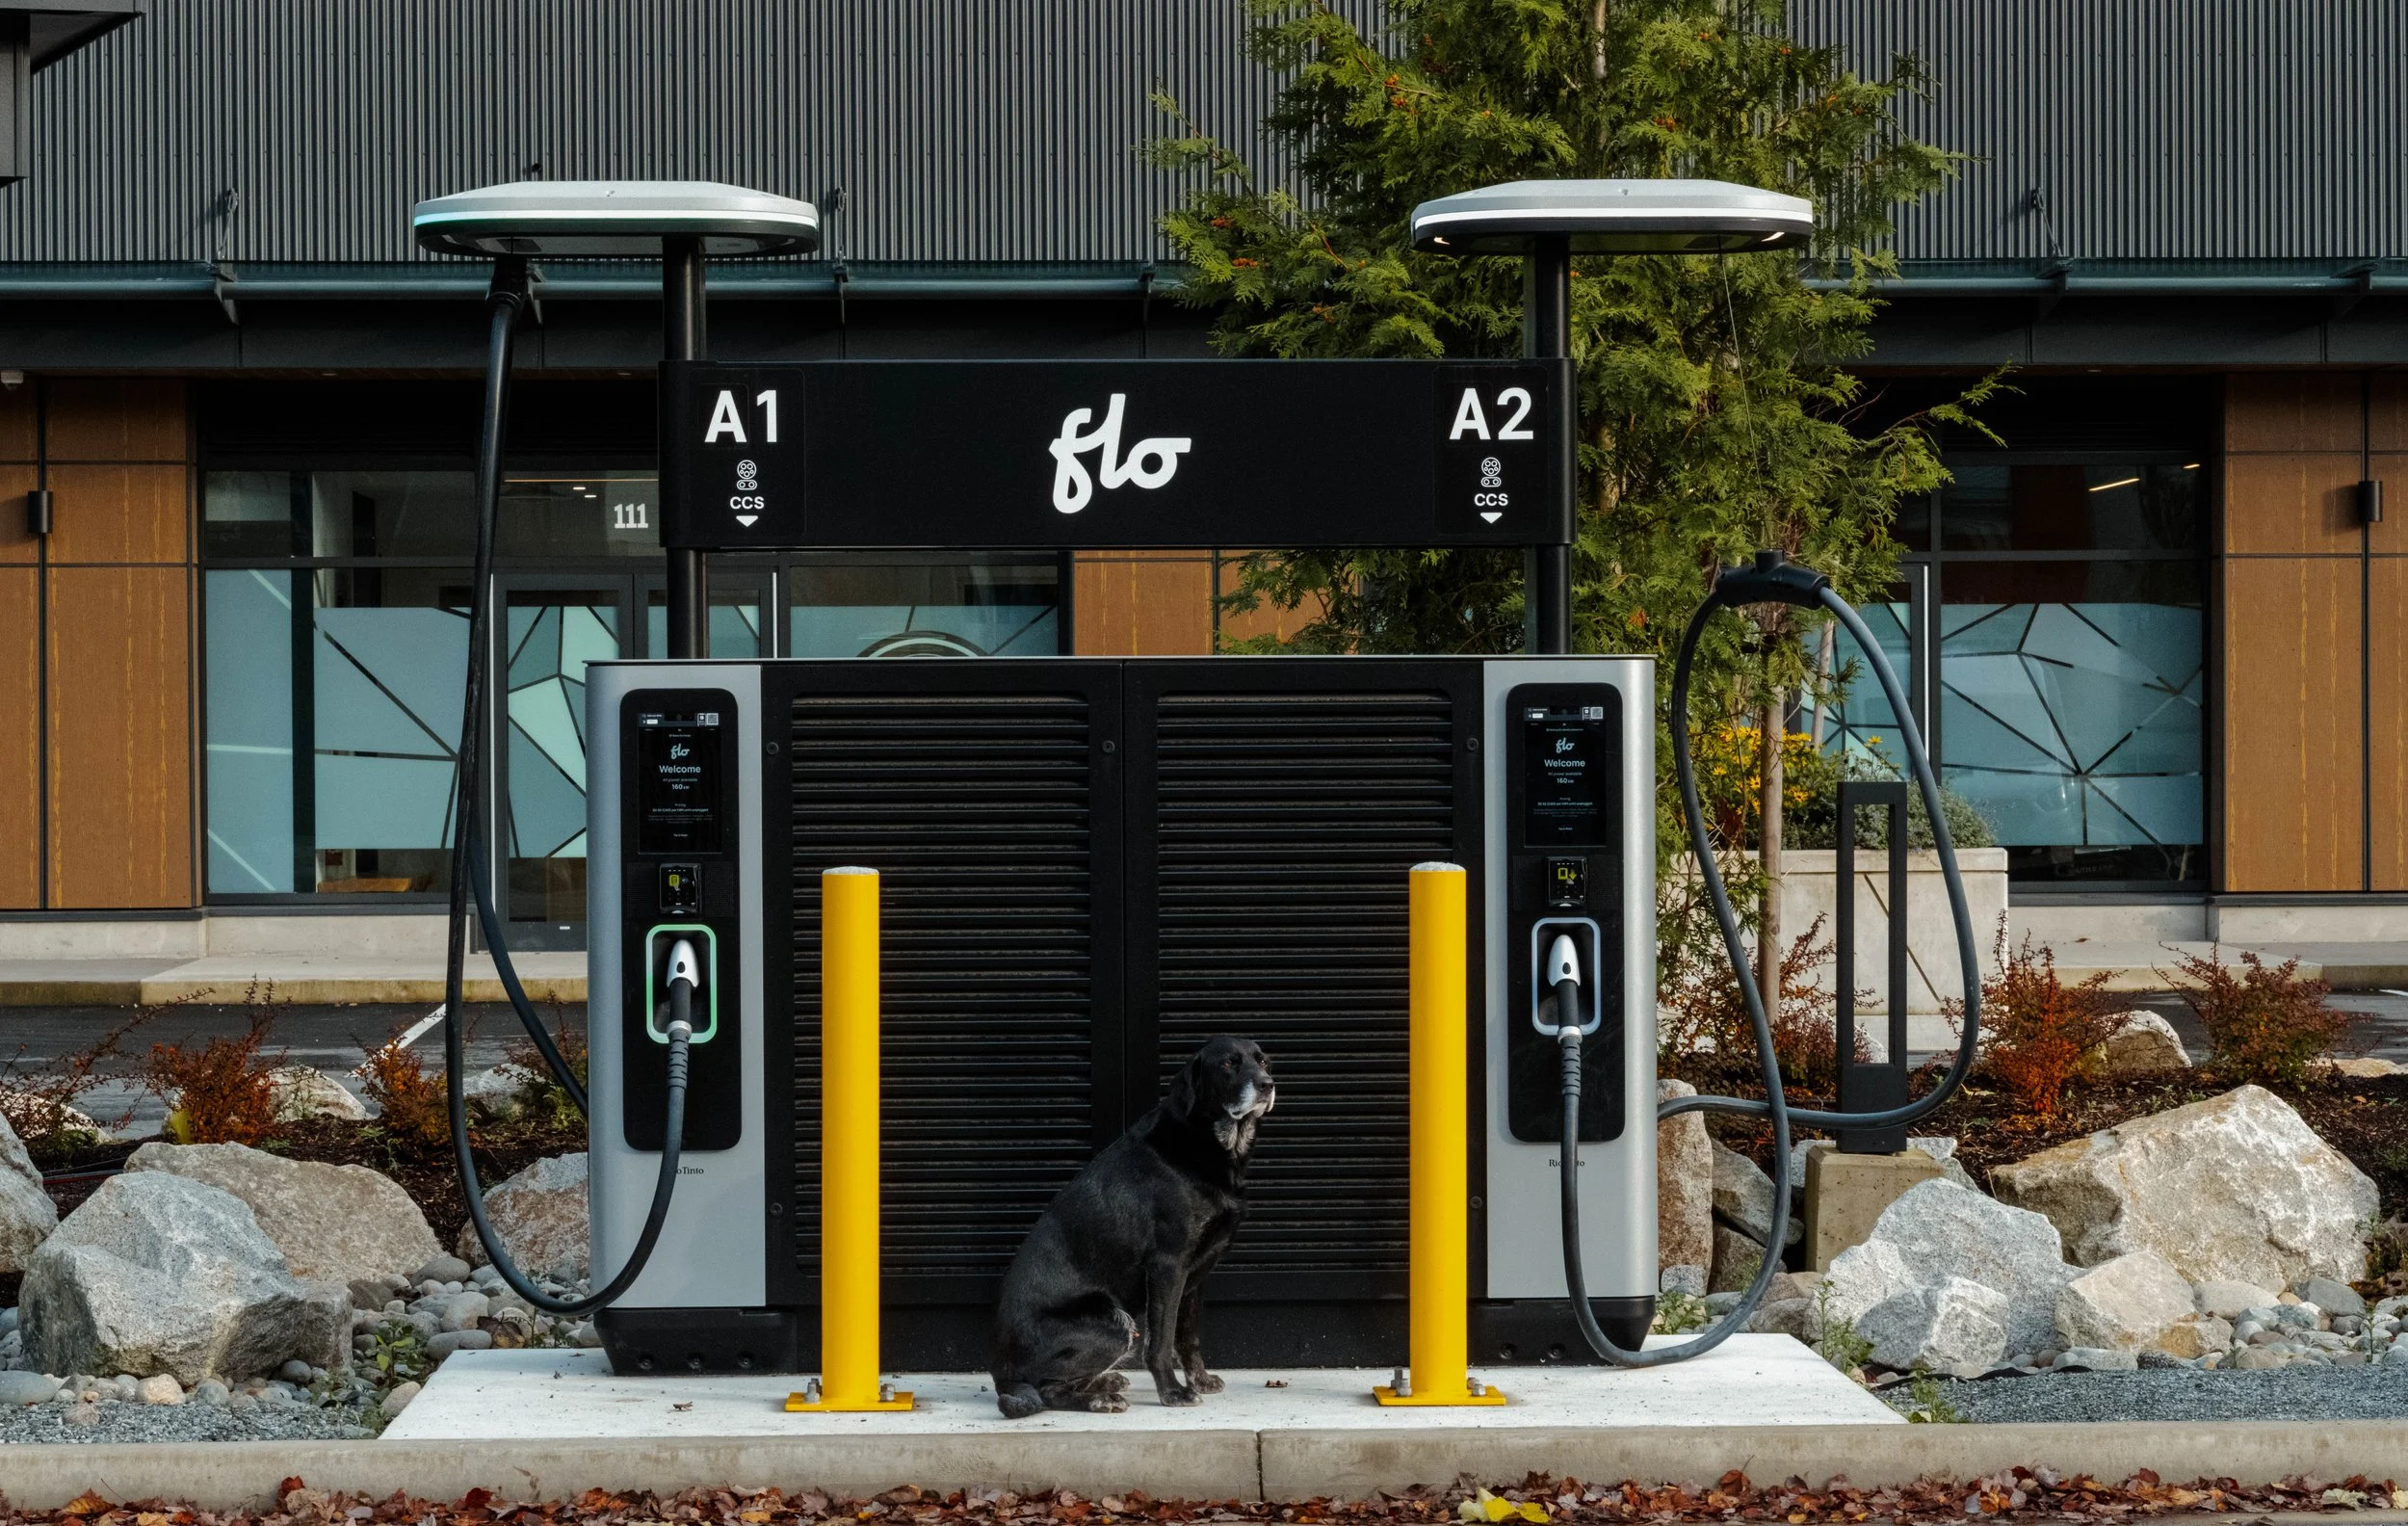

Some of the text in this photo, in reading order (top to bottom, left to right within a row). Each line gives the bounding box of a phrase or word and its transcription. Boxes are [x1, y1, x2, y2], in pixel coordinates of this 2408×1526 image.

[705, 390, 777, 443] A1
[1450, 387, 1534, 440] A2
[1048, 392, 1192, 514] flo
[729, 495, 765, 510] CCS
[1474, 493, 1509, 507] CCS
[614, 503, 649, 529] 111
[670, 743, 690, 760] flo
[1556, 737, 1575, 754] flo
[659, 765, 701, 774] Welcome
[1544, 758, 1586, 768] Welcome
